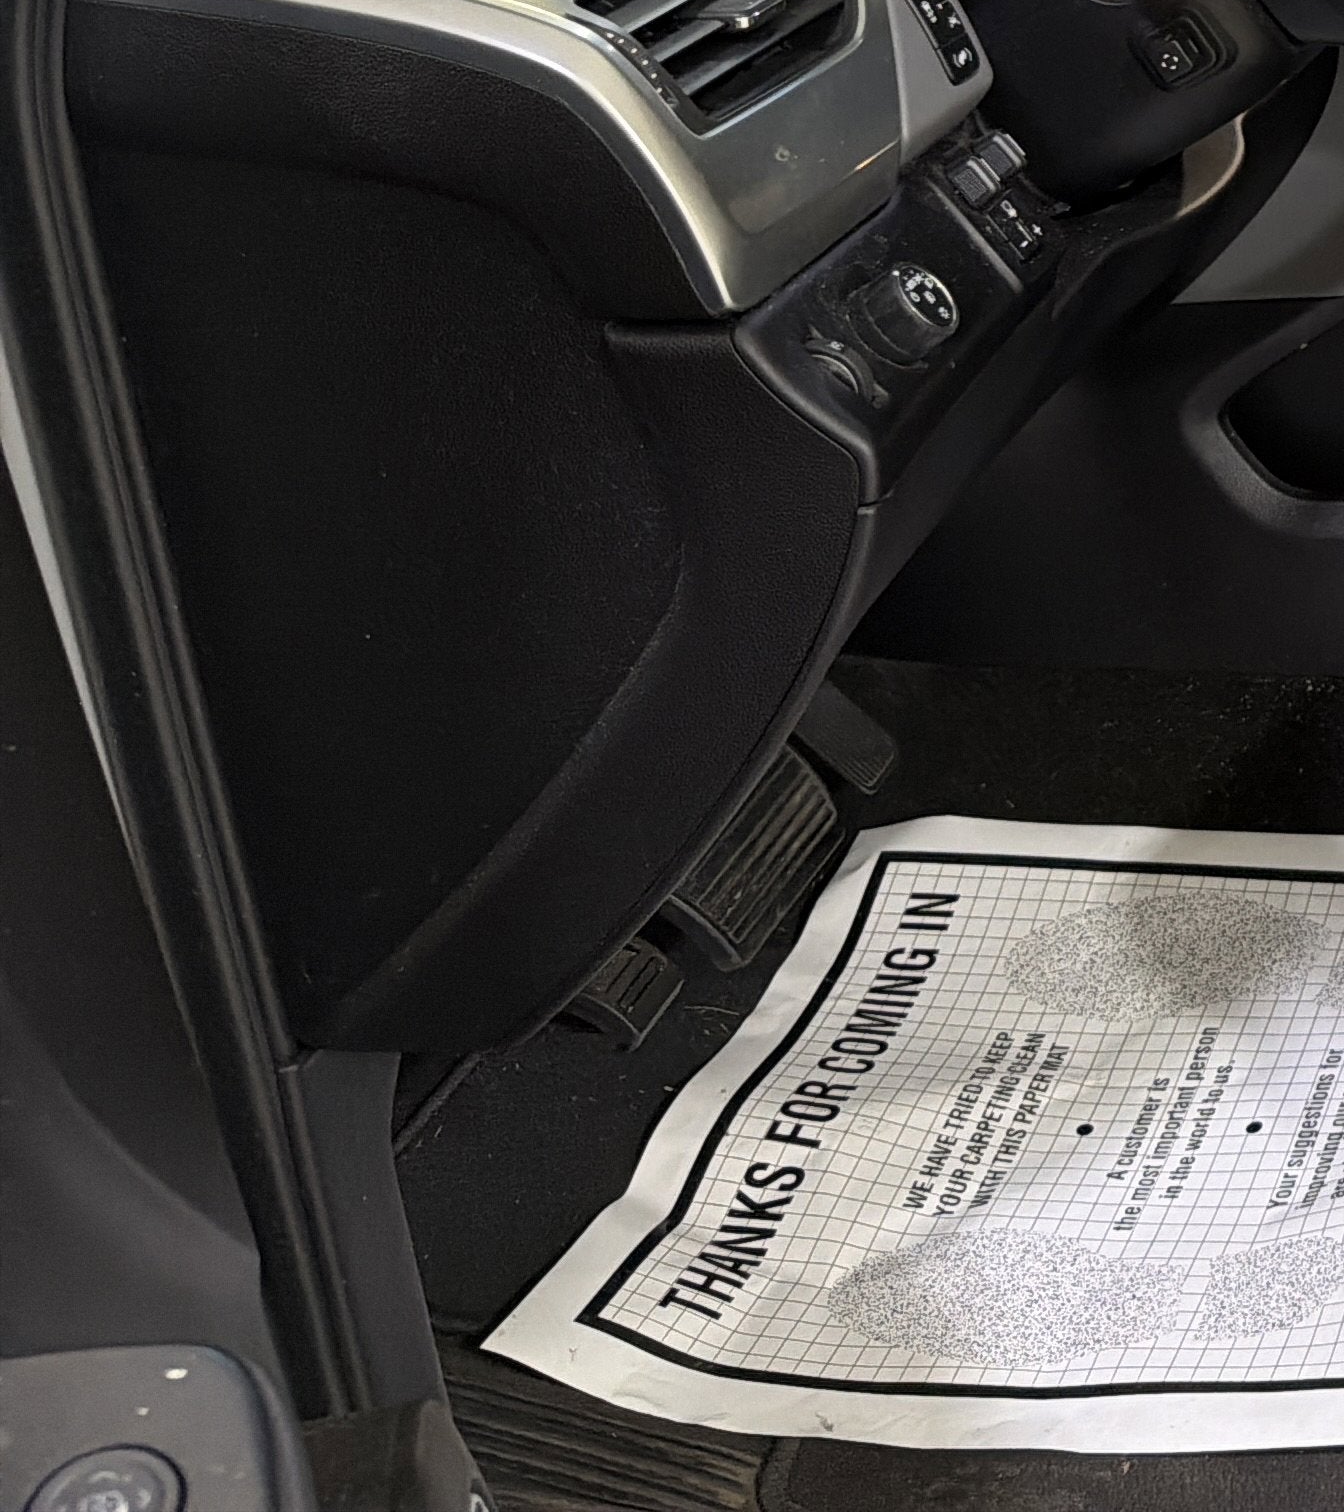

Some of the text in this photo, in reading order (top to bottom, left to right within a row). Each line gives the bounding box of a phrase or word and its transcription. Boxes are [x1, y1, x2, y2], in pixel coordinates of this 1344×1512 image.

[658, 892, 960, 1320] THANKS FOR COMING IN
[902, 1031, 1015, 1209] WE HAVE TRIED TO KEEP
[932, 1032, 1046, 1217] YOUR CARPETING CLEAN
[969, 1042, 1071, 1209] WITH THIS PAPER MAT
[1107, 1077, 1170, 1180] A customer is
[1113, 1026, 1220, 1231] the most important person
[1159, 1059, 1236, 1200] in the world to us.
[1266, 1048, 1344, 1210] Your suggestions for
